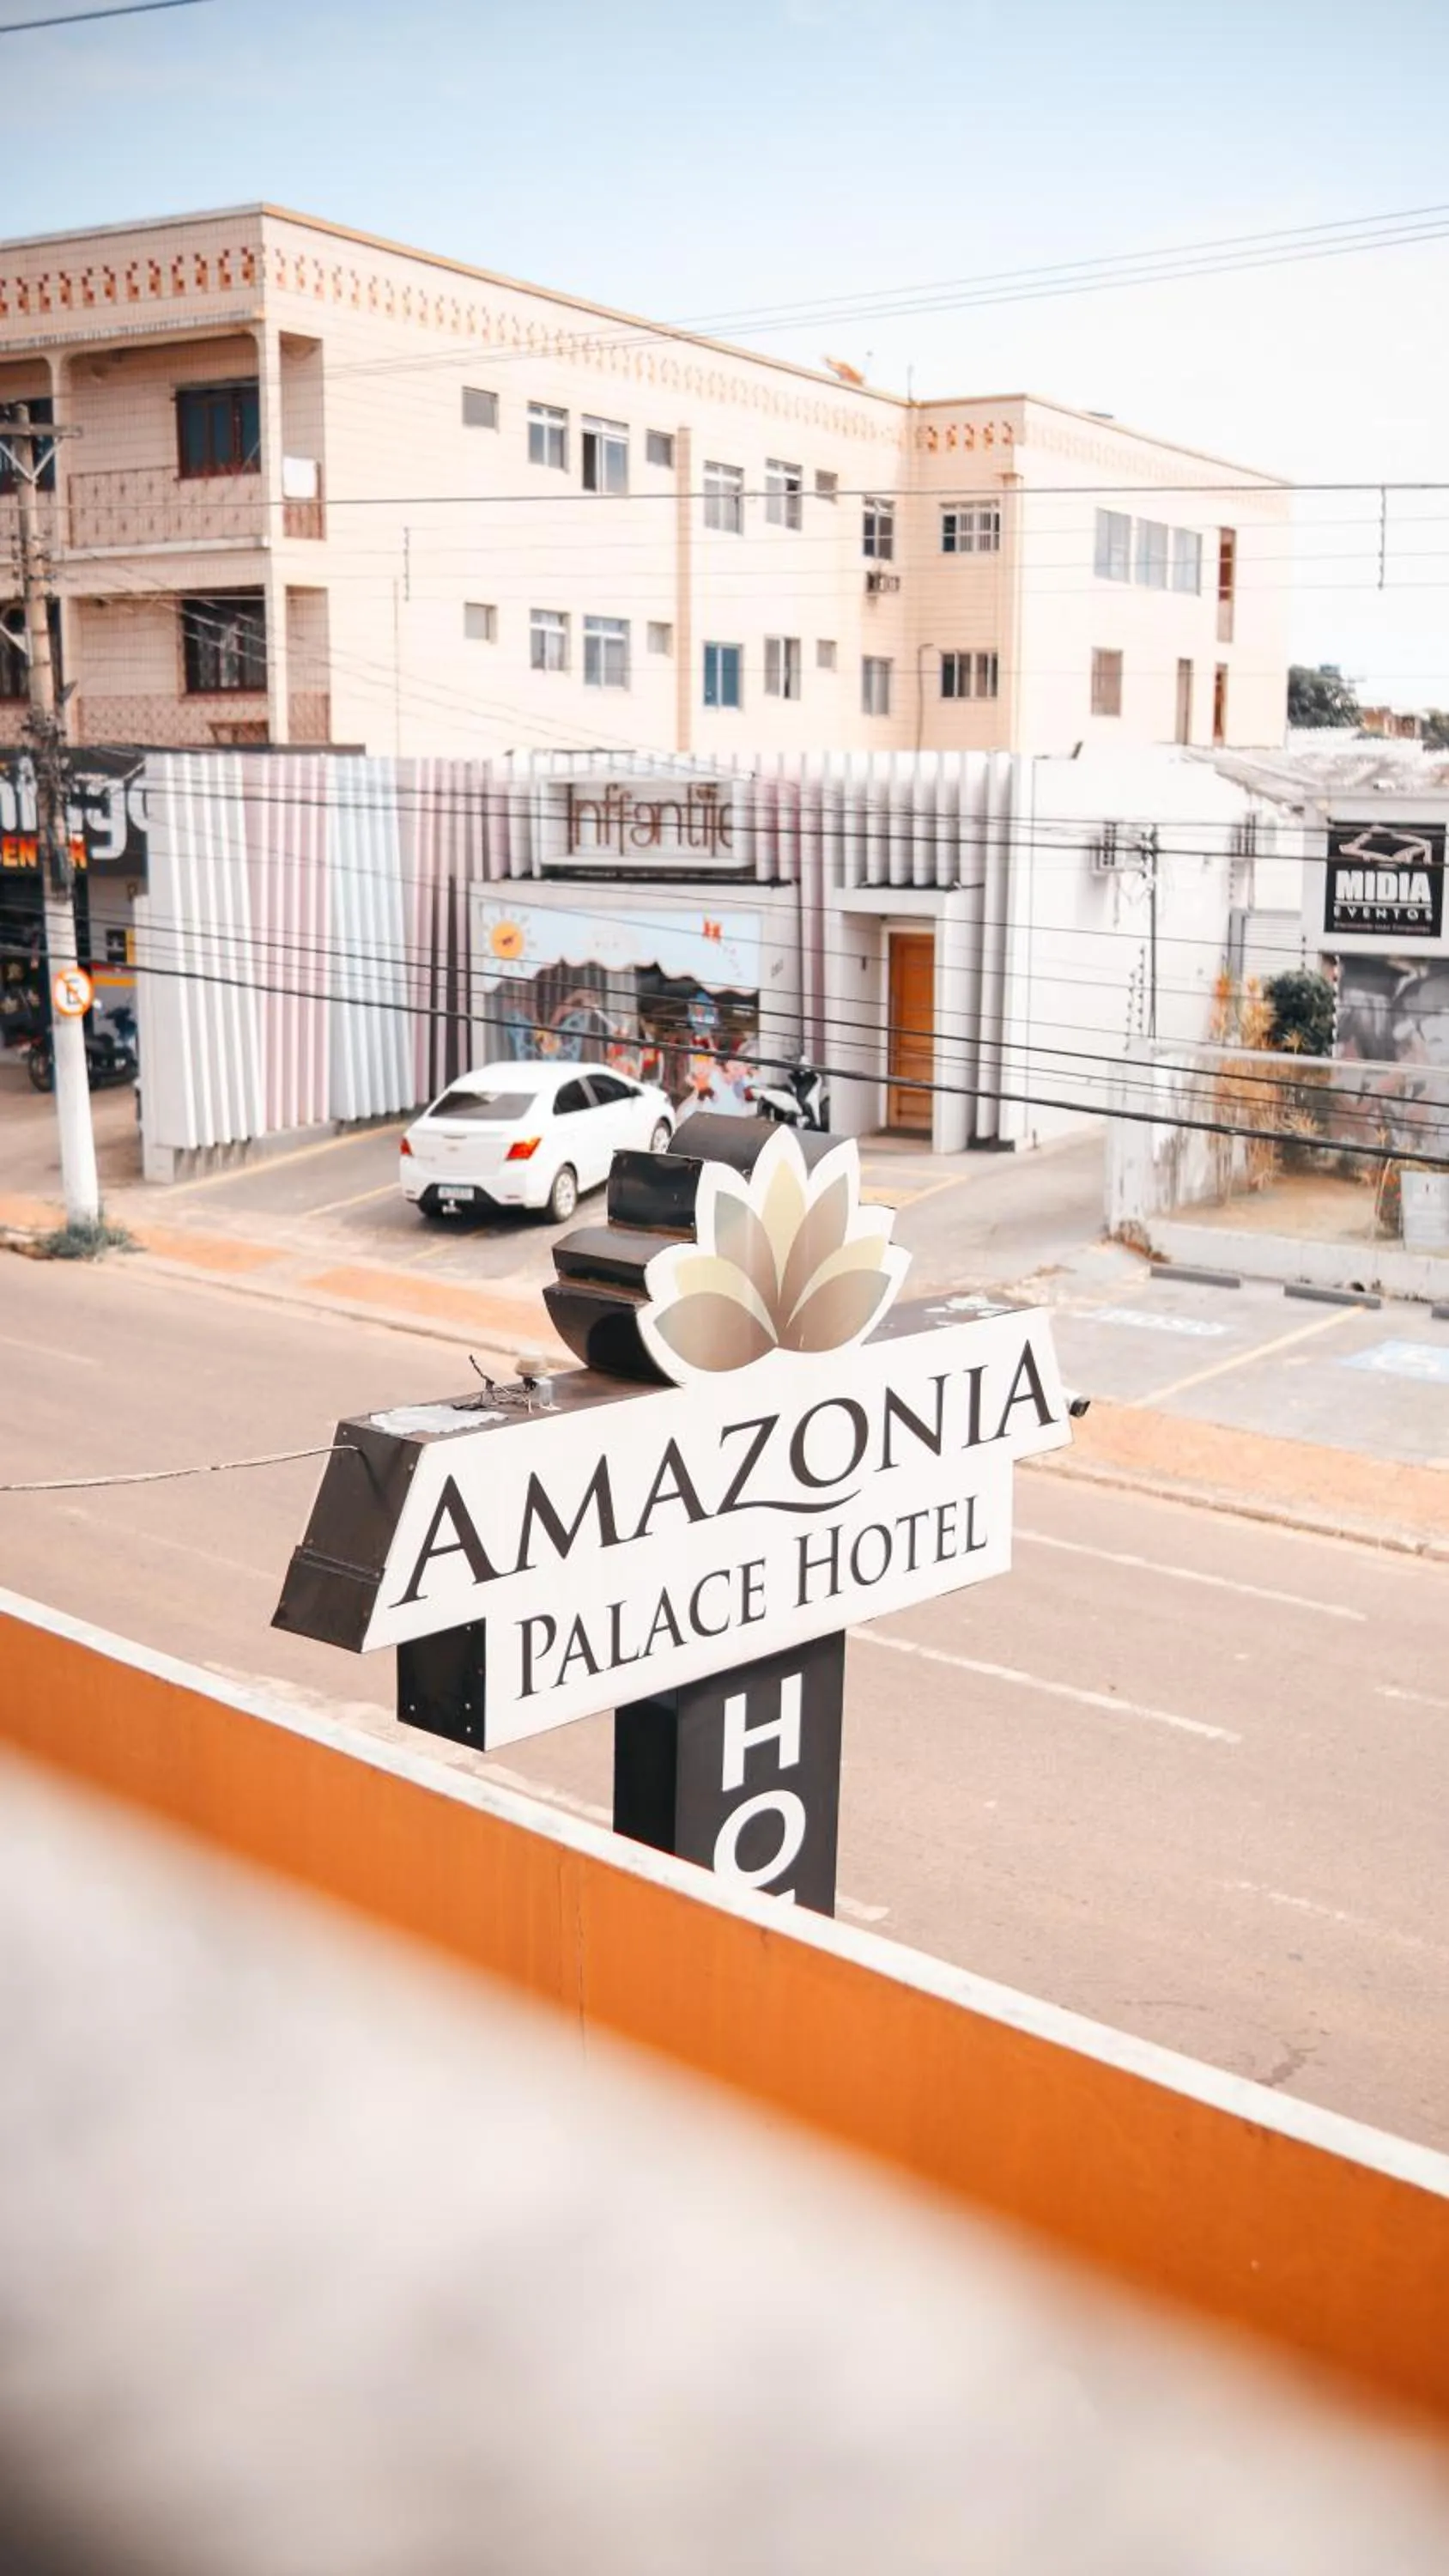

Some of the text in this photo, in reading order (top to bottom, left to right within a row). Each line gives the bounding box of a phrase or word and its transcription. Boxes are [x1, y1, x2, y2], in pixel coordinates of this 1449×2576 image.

[1333, 905, 1433, 922] EVENTOS
[1336, 870, 1432, 903] MIDIA
[389, 1339, 1059, 1608] AMAZONIA
[514, 1495, 989, 1700] PALACE HOTEL
[713, 1673, 808, 1904] HO
